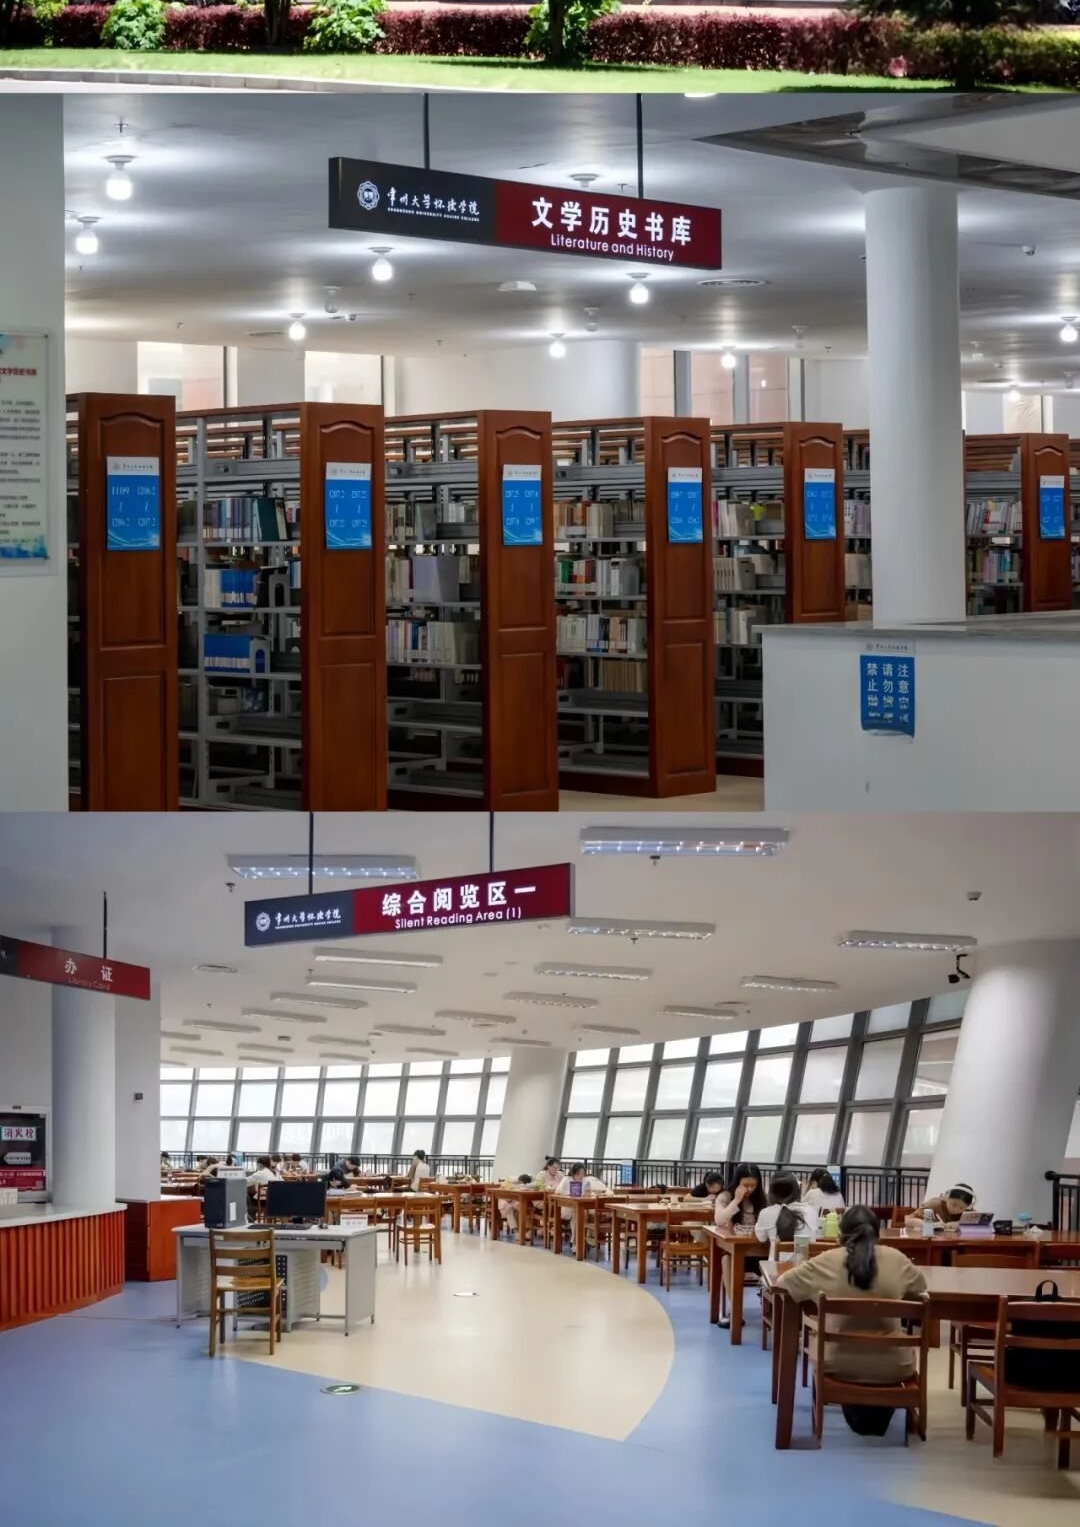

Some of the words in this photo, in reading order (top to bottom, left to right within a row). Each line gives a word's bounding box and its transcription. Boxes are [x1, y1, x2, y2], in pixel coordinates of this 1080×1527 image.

[531, 196, 692, 246] 文学历史书库
[550, 233, 609, 252] Literature
[611, 242, 634, 255] and
[636, 244, 674, 261] History
[382, 881, 537, 917] 综合阅览区一
[395, 916, 424, 929] Silent
[426, 912, 473, 926] Reading
[475, 909, 503, 921] Area
[506, 906, 522, 920] (1)
[65, 958, 113, 982] 办证
[4, 1128, 34, 1138] 消火栓
